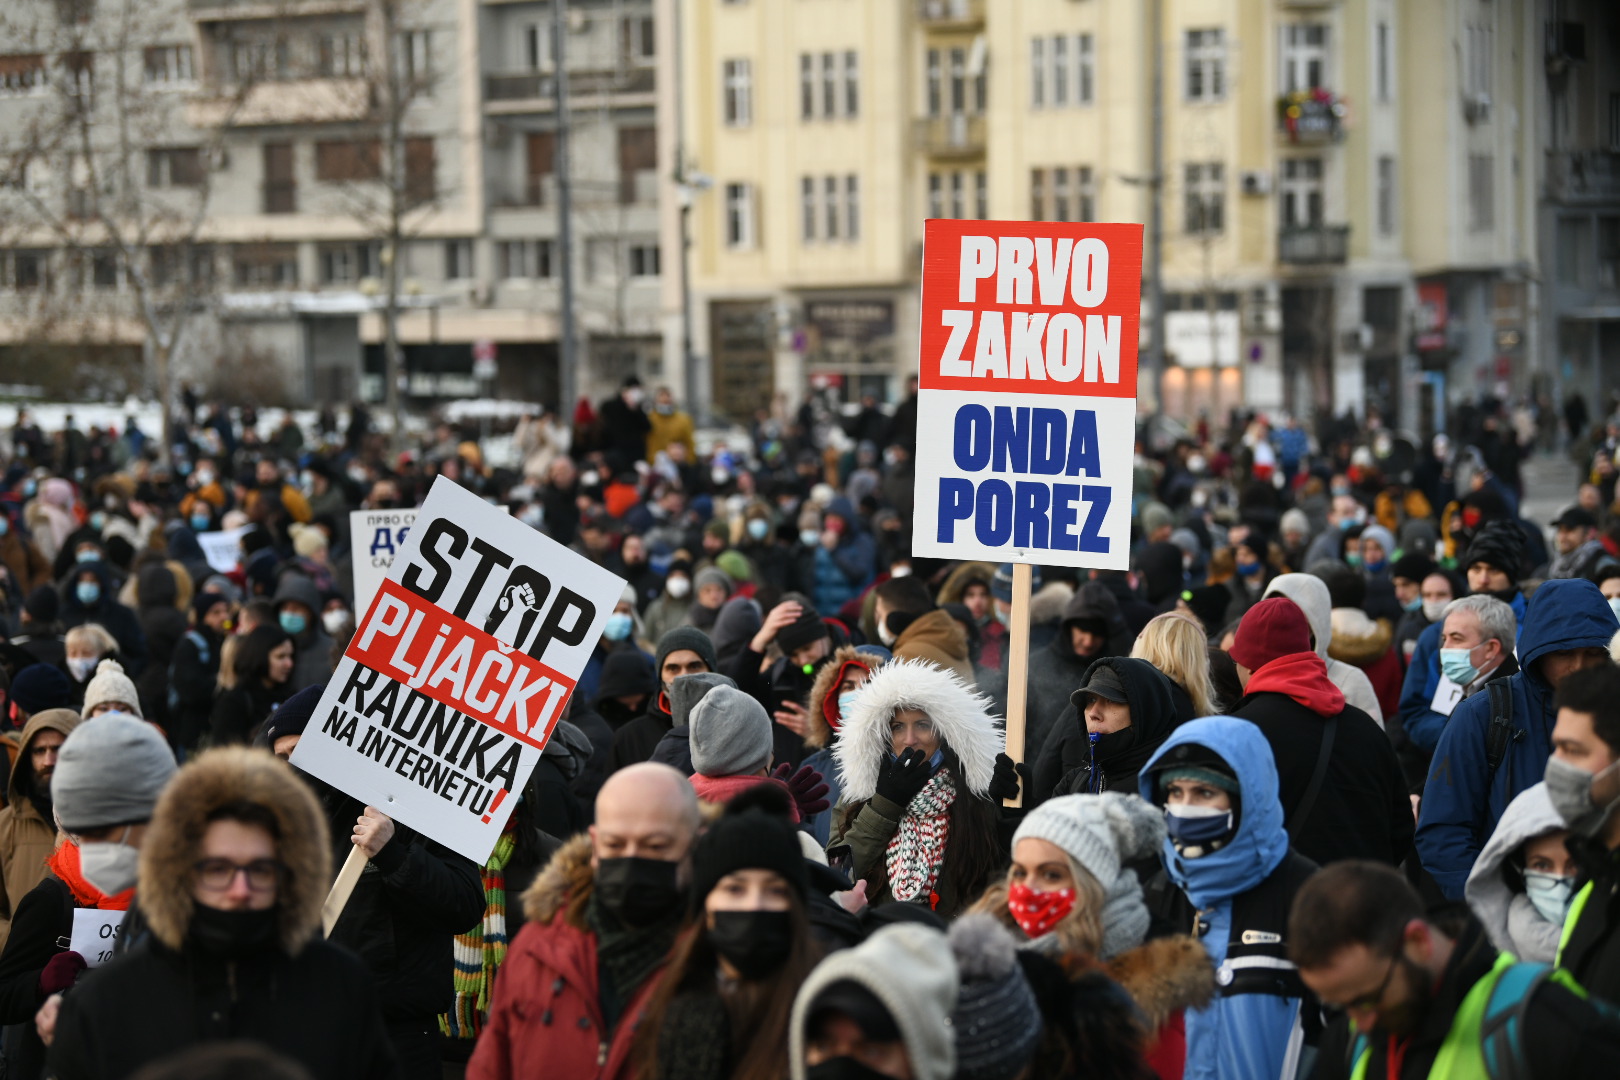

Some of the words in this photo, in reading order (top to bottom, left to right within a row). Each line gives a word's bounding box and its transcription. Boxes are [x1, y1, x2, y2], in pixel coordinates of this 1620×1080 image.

[959, 236, 1108, 307] PRVO
[940, 310, 1121, 383] ZAKON
[954, 404, 1101, 478] ONDA
[367, 515, 400, 525] ПРВО
[937, 477, 1111, 553] POREZ
[402, 518, 595, 661] STOP
[338, 662, 522, 793] RADNIKA
[322, 706, 357, 747] NA
[357, 725, 509, 825] INTERNETU!
